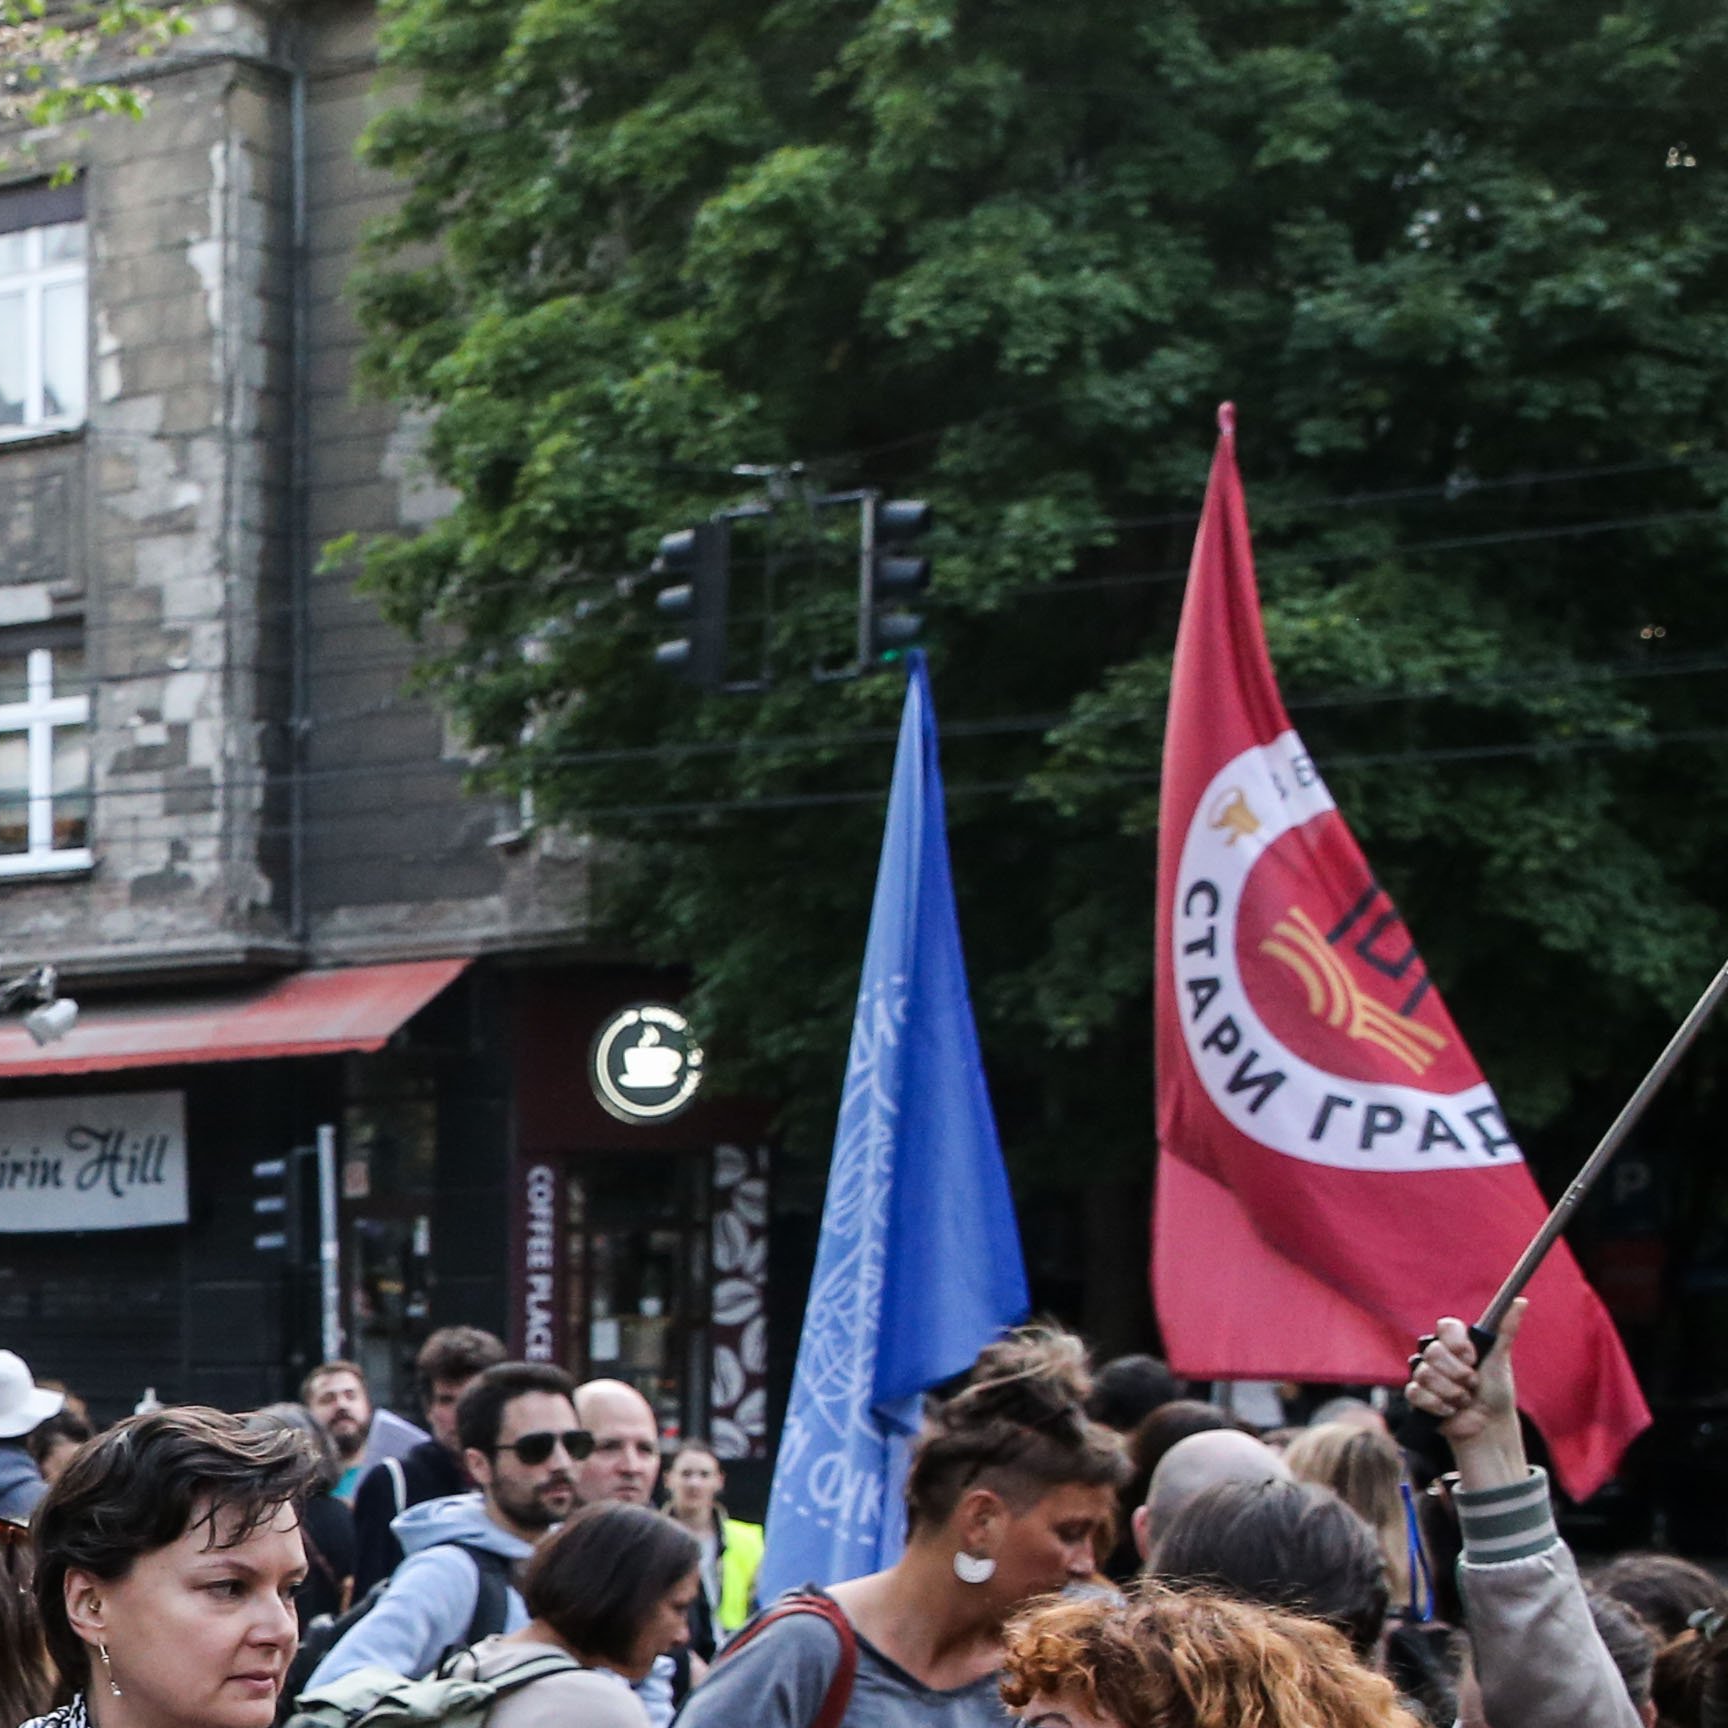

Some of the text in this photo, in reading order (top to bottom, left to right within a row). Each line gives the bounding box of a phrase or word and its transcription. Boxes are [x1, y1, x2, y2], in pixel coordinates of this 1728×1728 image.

[1184, 879, 1287, 1114] СТАРИ
[1307, 1094, 1516, 1157] ГРАД
[64, 1124, 169, 1198] Hill
[525, 1165, 554, 1361] COFFEE PLACE
